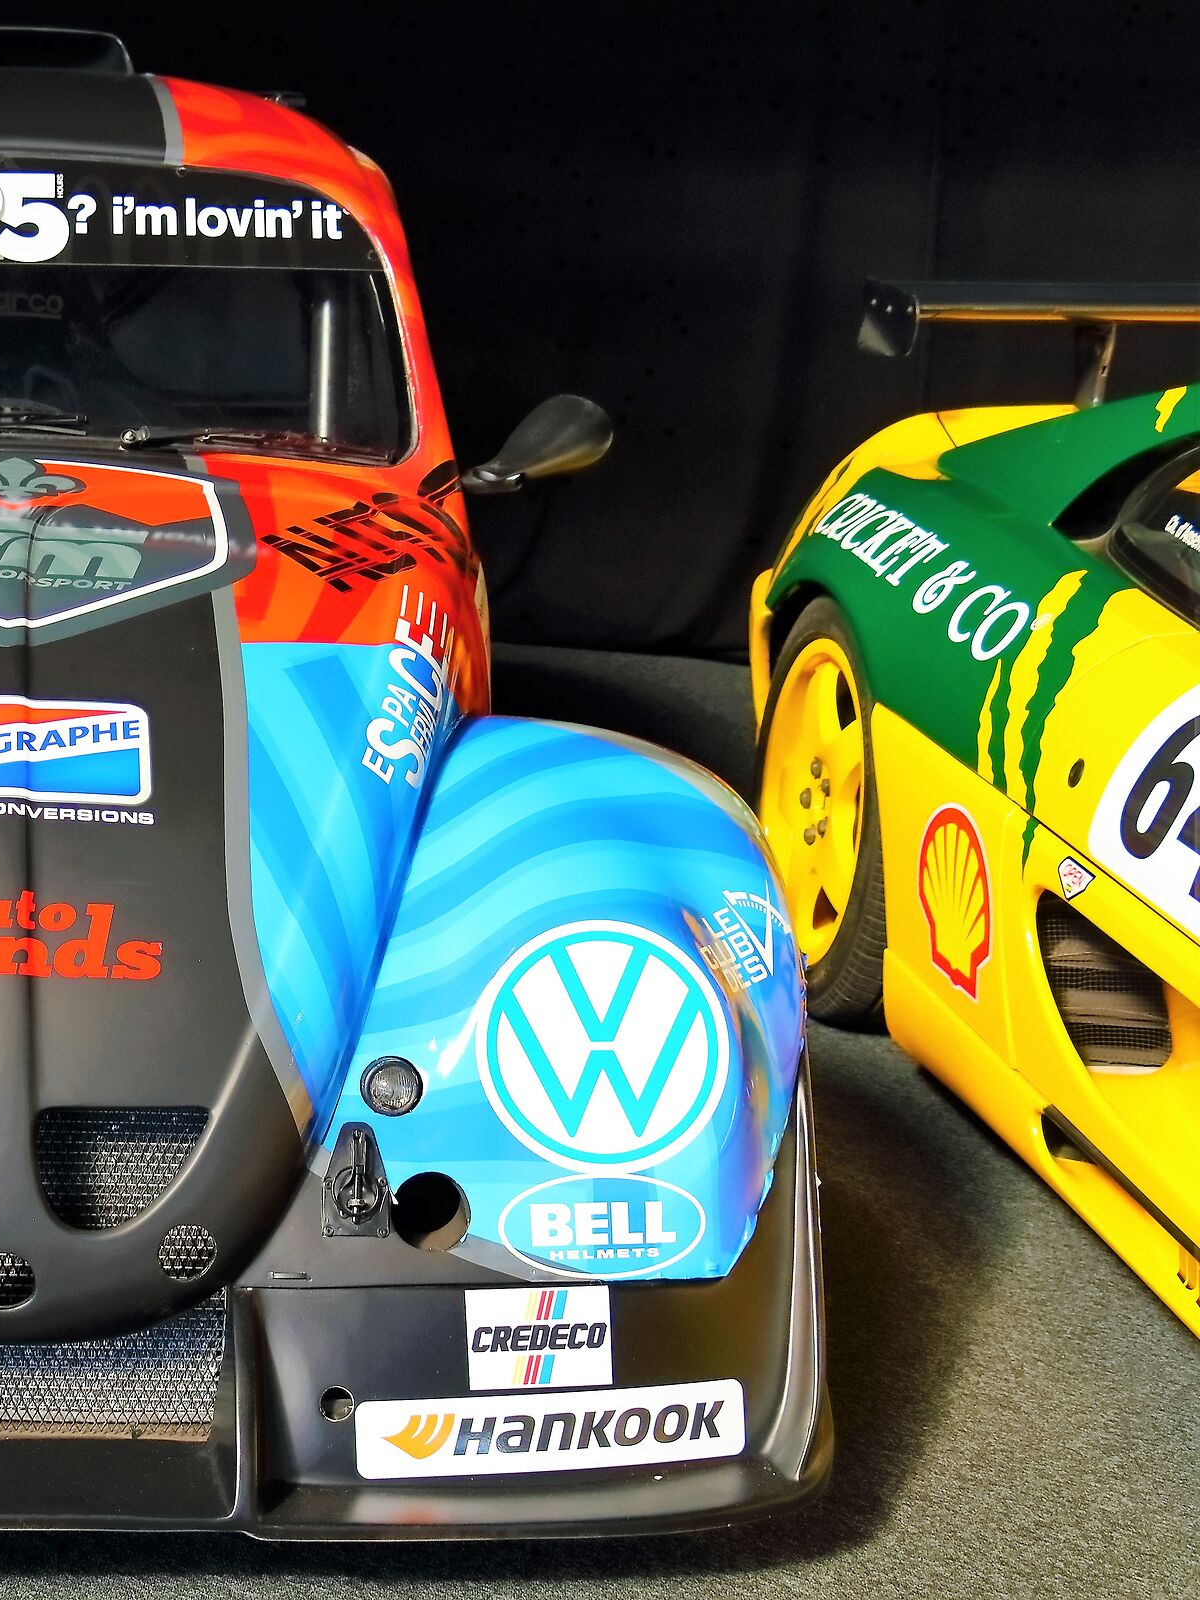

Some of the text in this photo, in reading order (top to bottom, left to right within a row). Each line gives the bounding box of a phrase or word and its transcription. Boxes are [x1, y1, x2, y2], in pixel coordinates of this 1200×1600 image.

[112, 196, 178, 236] i'm
[186, 197, 303, 238] lovin'
[310, 200, 343, 240] it
[813, 493, 1030, 661] CRICKET & CO
[702, 907, 740, 939] LE
[529, 1201, 676, 1247] BELL
[550, 1247, 660, 1260] HELMETS
[471, 1322, 608, 1353] CREDECO
